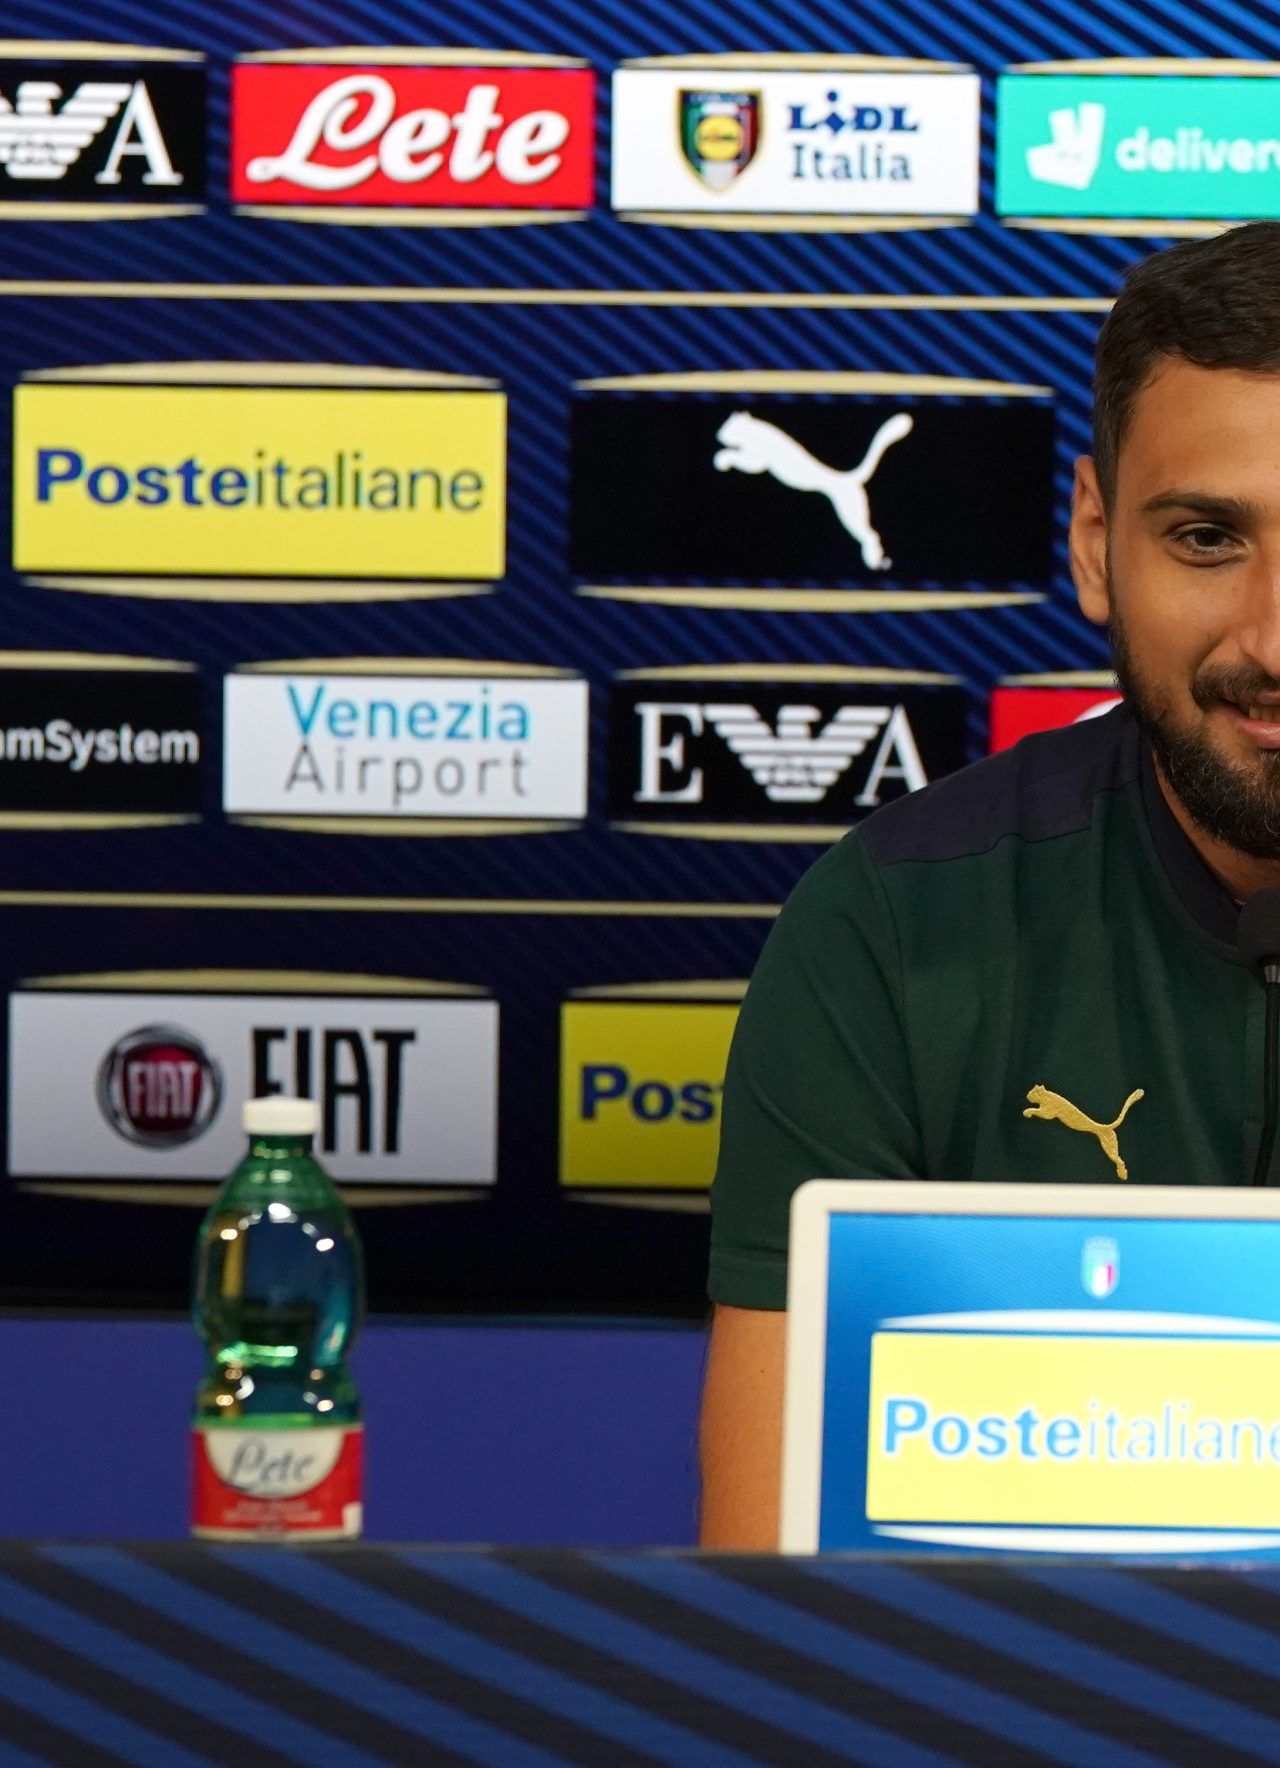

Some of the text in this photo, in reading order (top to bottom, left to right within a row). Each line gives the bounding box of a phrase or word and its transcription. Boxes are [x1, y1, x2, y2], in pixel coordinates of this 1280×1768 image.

[246, 75, 570, 190] Lete
[793, 144, 911, 181] Italia
[36, 448, 484, 512] Posteitaliane
[288, 683, 531, 741] Venezia
[284, 741, 527, 805] Airport
[127, 1061, 198, 1119] FIAT
[252, 1025, 416, 1154] FIAT
[581, 1063, 724, 1123] Pos
